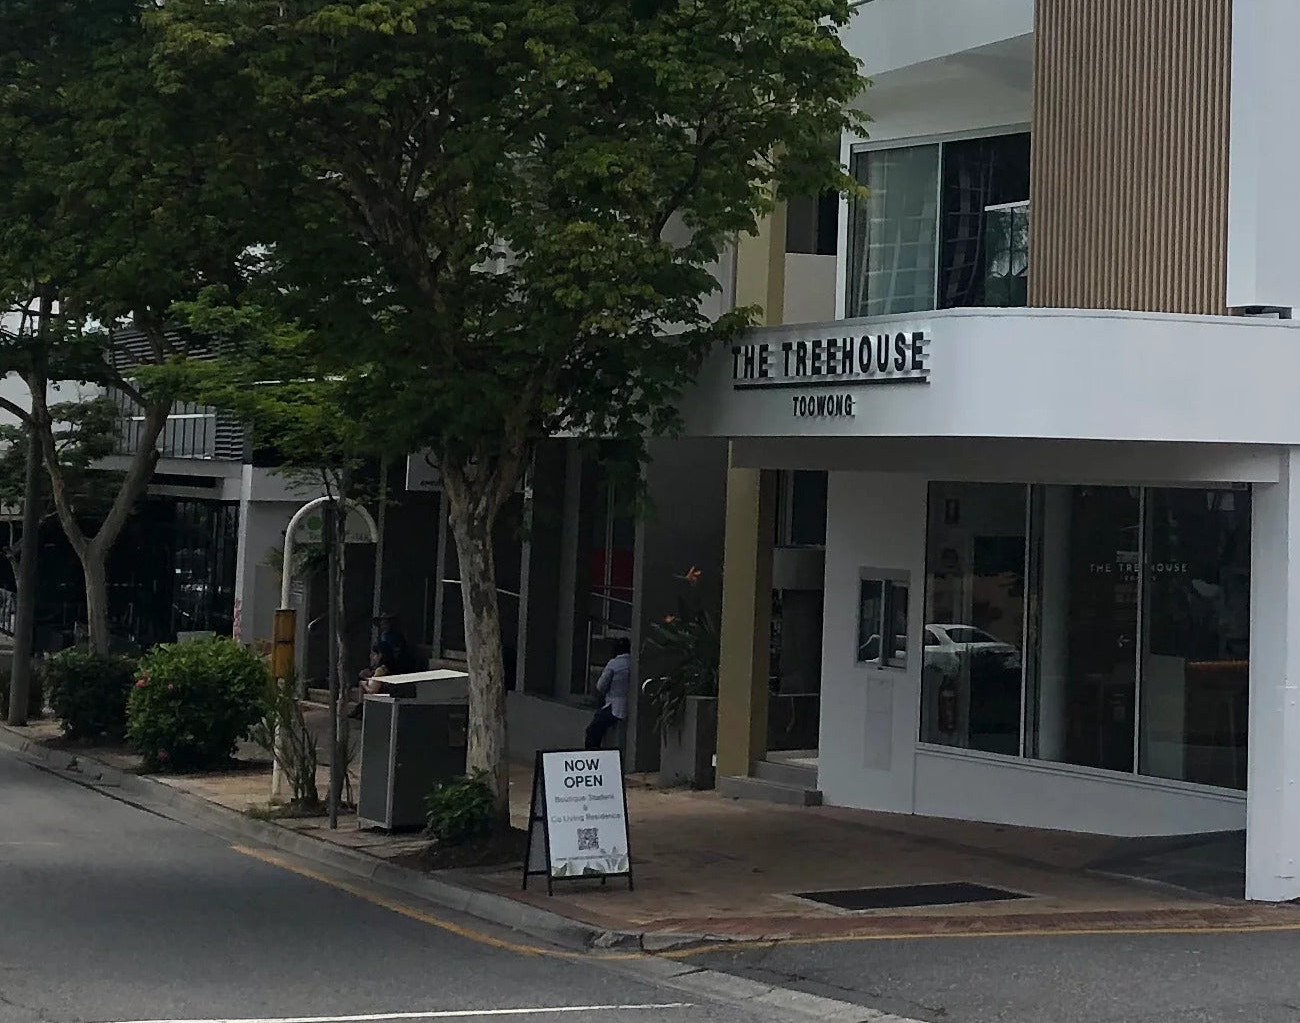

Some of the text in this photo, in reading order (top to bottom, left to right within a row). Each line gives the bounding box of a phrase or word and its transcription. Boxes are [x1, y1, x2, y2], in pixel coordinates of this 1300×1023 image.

[732, 331, 925, 378] THE TREEHOUSE
[793, 394, 852, 417] TOOWONG
[1119, 563, 1188, 573] TREOUSE
[564, 758, 600, 772] NOW
[564, 774, 603, 789] OPEN
